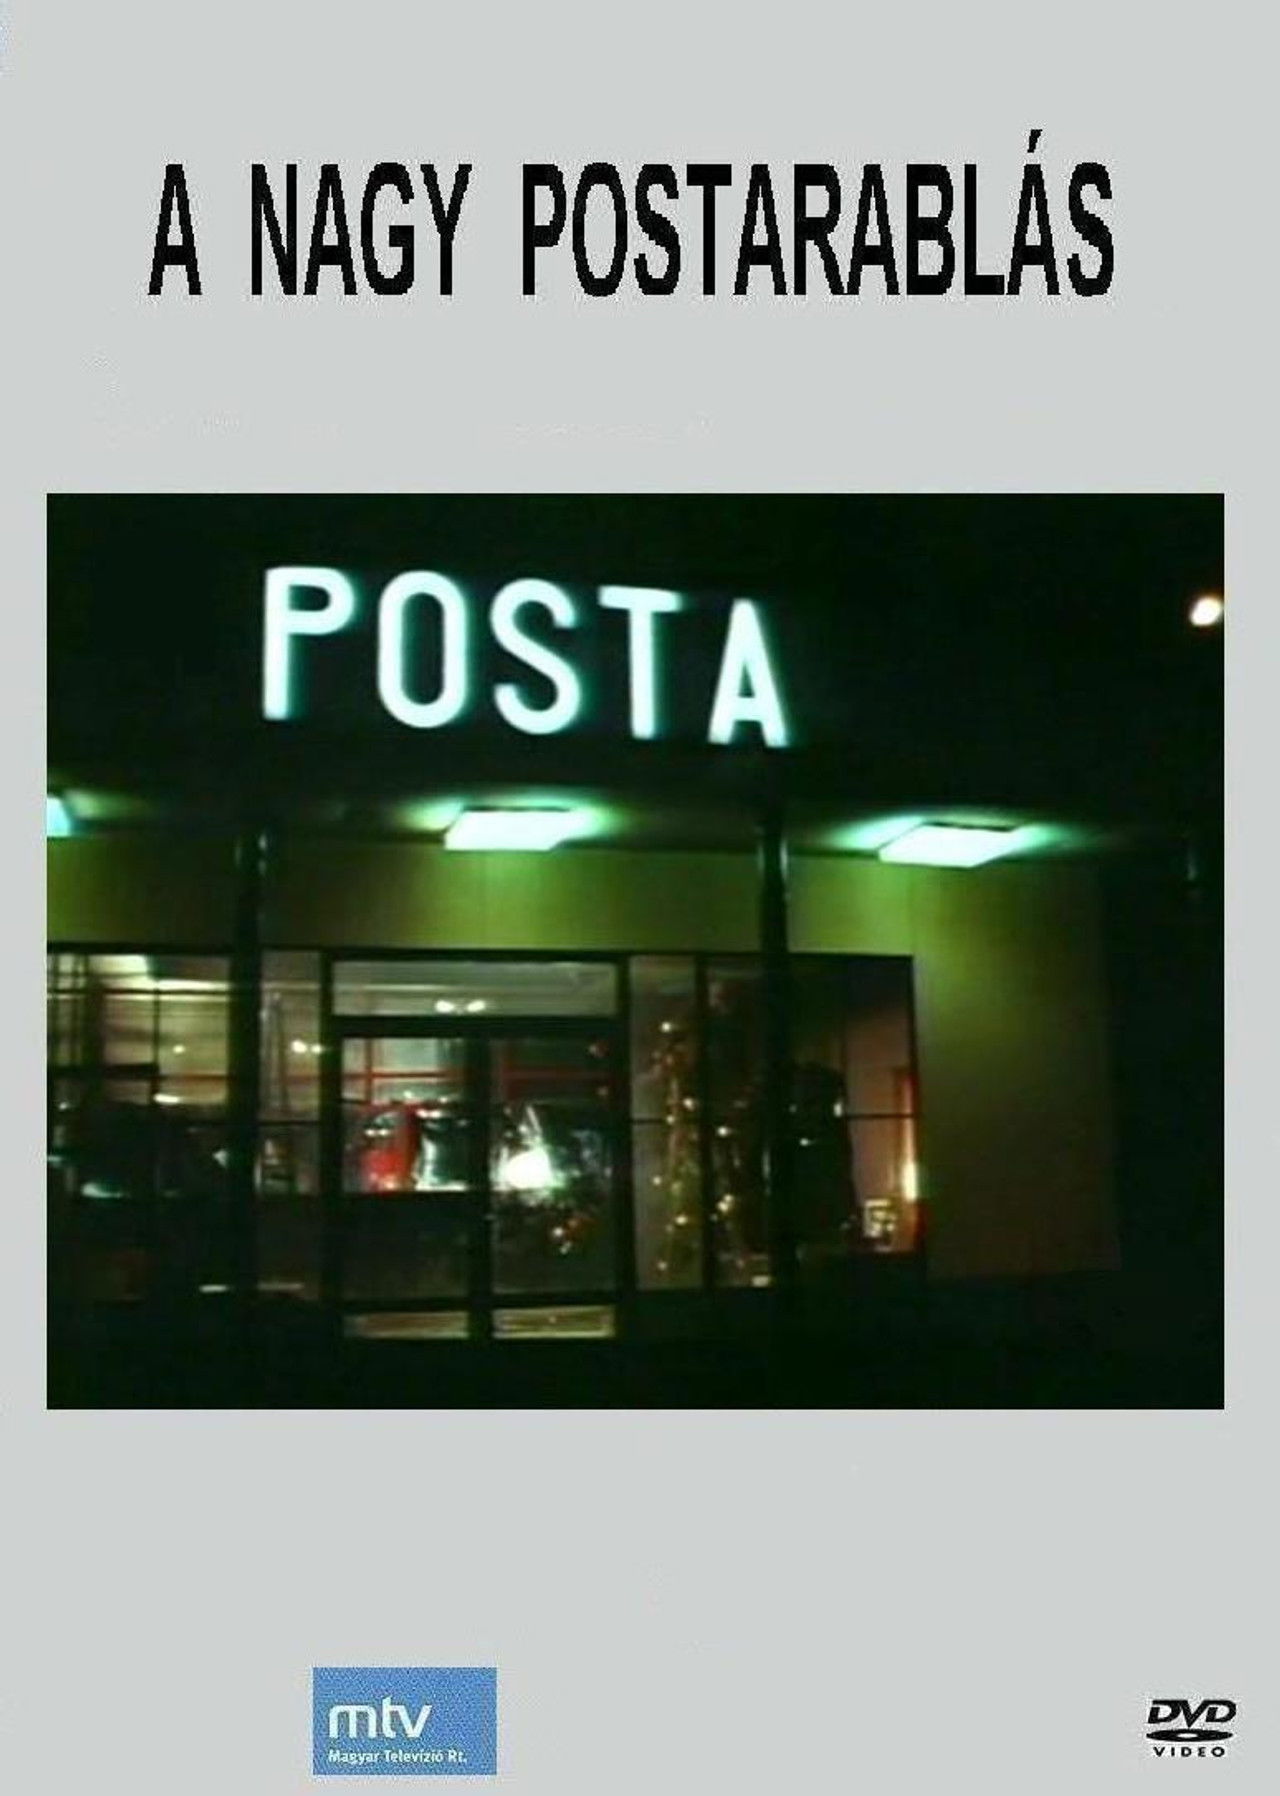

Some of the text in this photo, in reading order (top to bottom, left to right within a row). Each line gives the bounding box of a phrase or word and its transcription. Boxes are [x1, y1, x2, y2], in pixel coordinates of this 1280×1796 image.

[147, 128, 1115, 298] A NAGY POSTARABLÁS
[263, 566, 790, 747] POSTA
[328, 1695, 433, 1739] mtv
[1147, 1699, 1237, 1728] DVD
[328, 1749, 380, 1765] Magyar
[447, 1749, 469, 1763] Rt.
[1152, 1746, 1226, 1758] VIDEO
